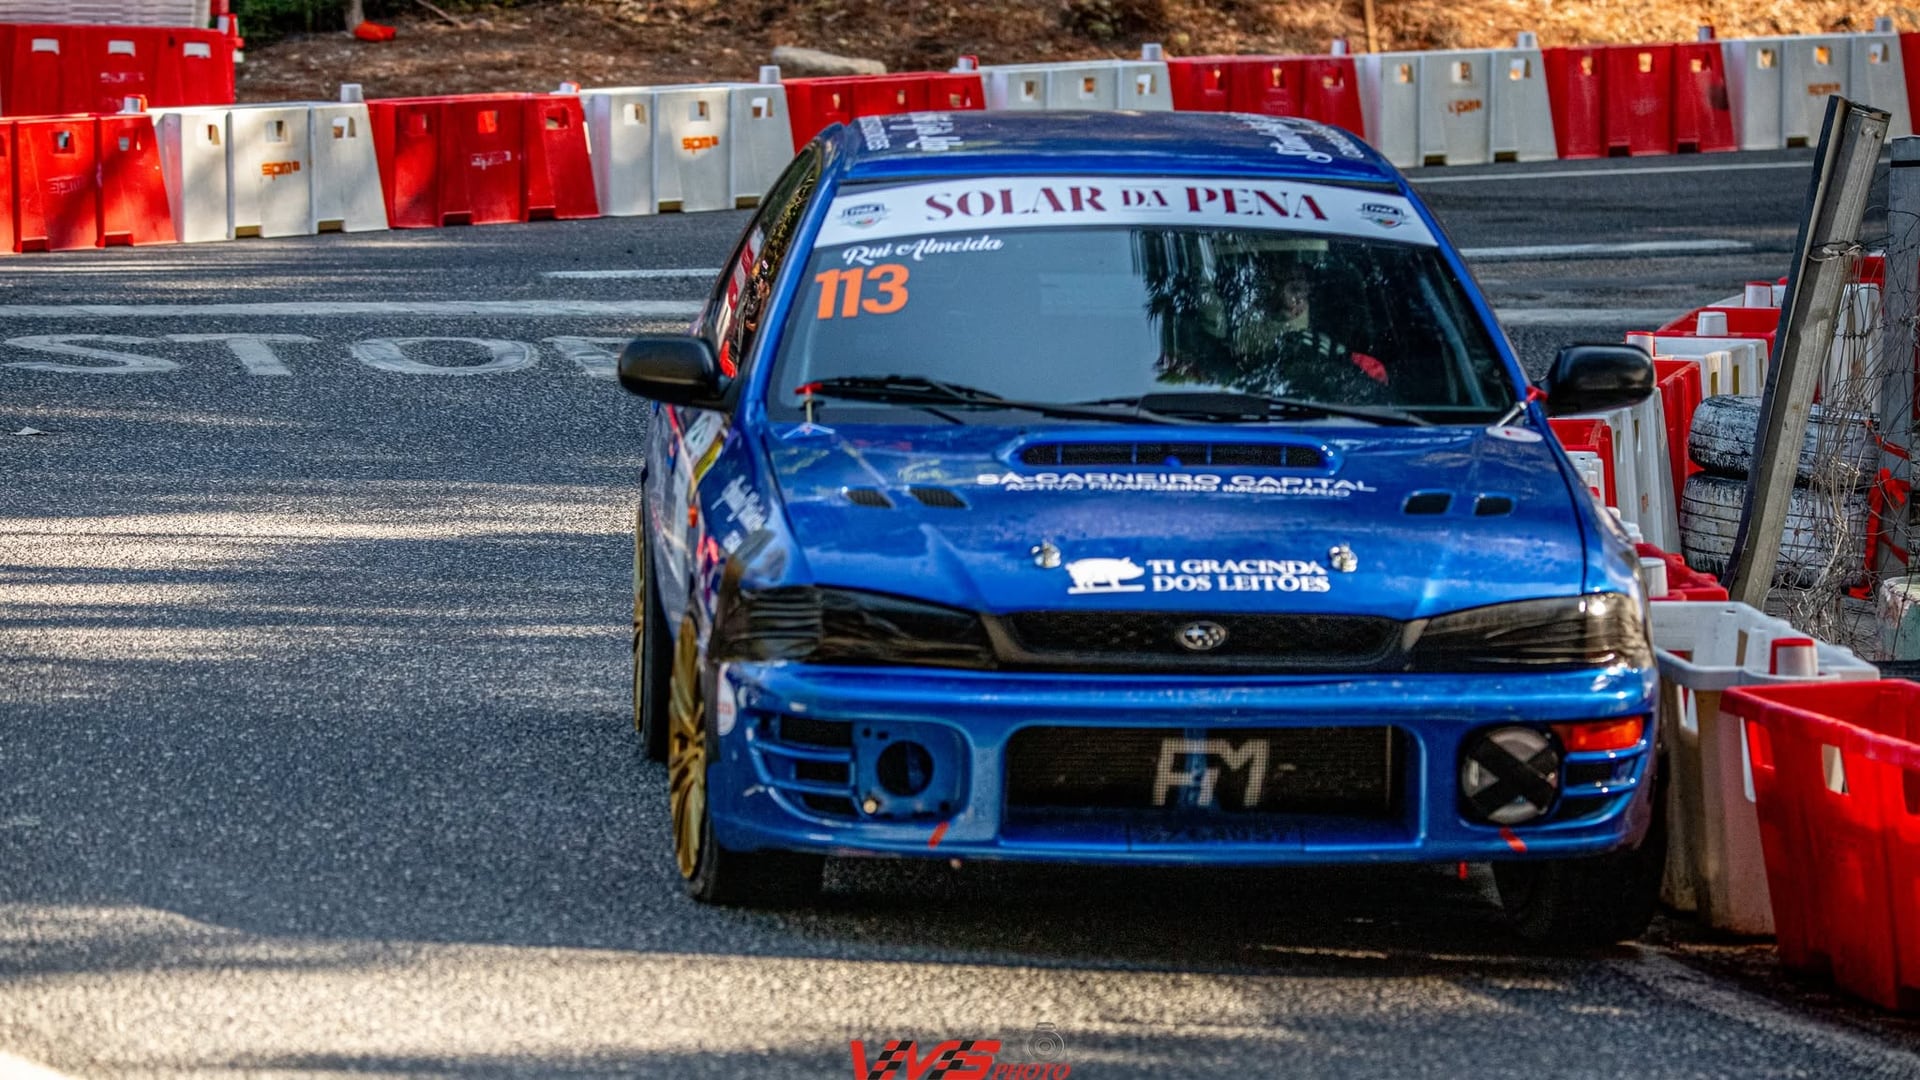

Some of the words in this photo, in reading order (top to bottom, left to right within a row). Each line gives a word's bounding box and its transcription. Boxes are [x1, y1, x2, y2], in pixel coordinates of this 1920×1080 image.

[925, 185, 1107, 221] SOLAR
[1121, 189, 1169, 207] DA
[1185, 186, 1329, 221] PENA
[842, 243, 892, 265] Rui
[895, 234, 1004, 261] Almeida
[815, 263, 909, 319] 113
[1231, 475, 1377, 492] CAPITAL
[1146, 559, 1176, 574] TI
[1181, 559, 1328, 575] GRACINDA
[1152, 574, 1212, 592] DOS
[1218, 572, 1330, 593] LEITÕES
